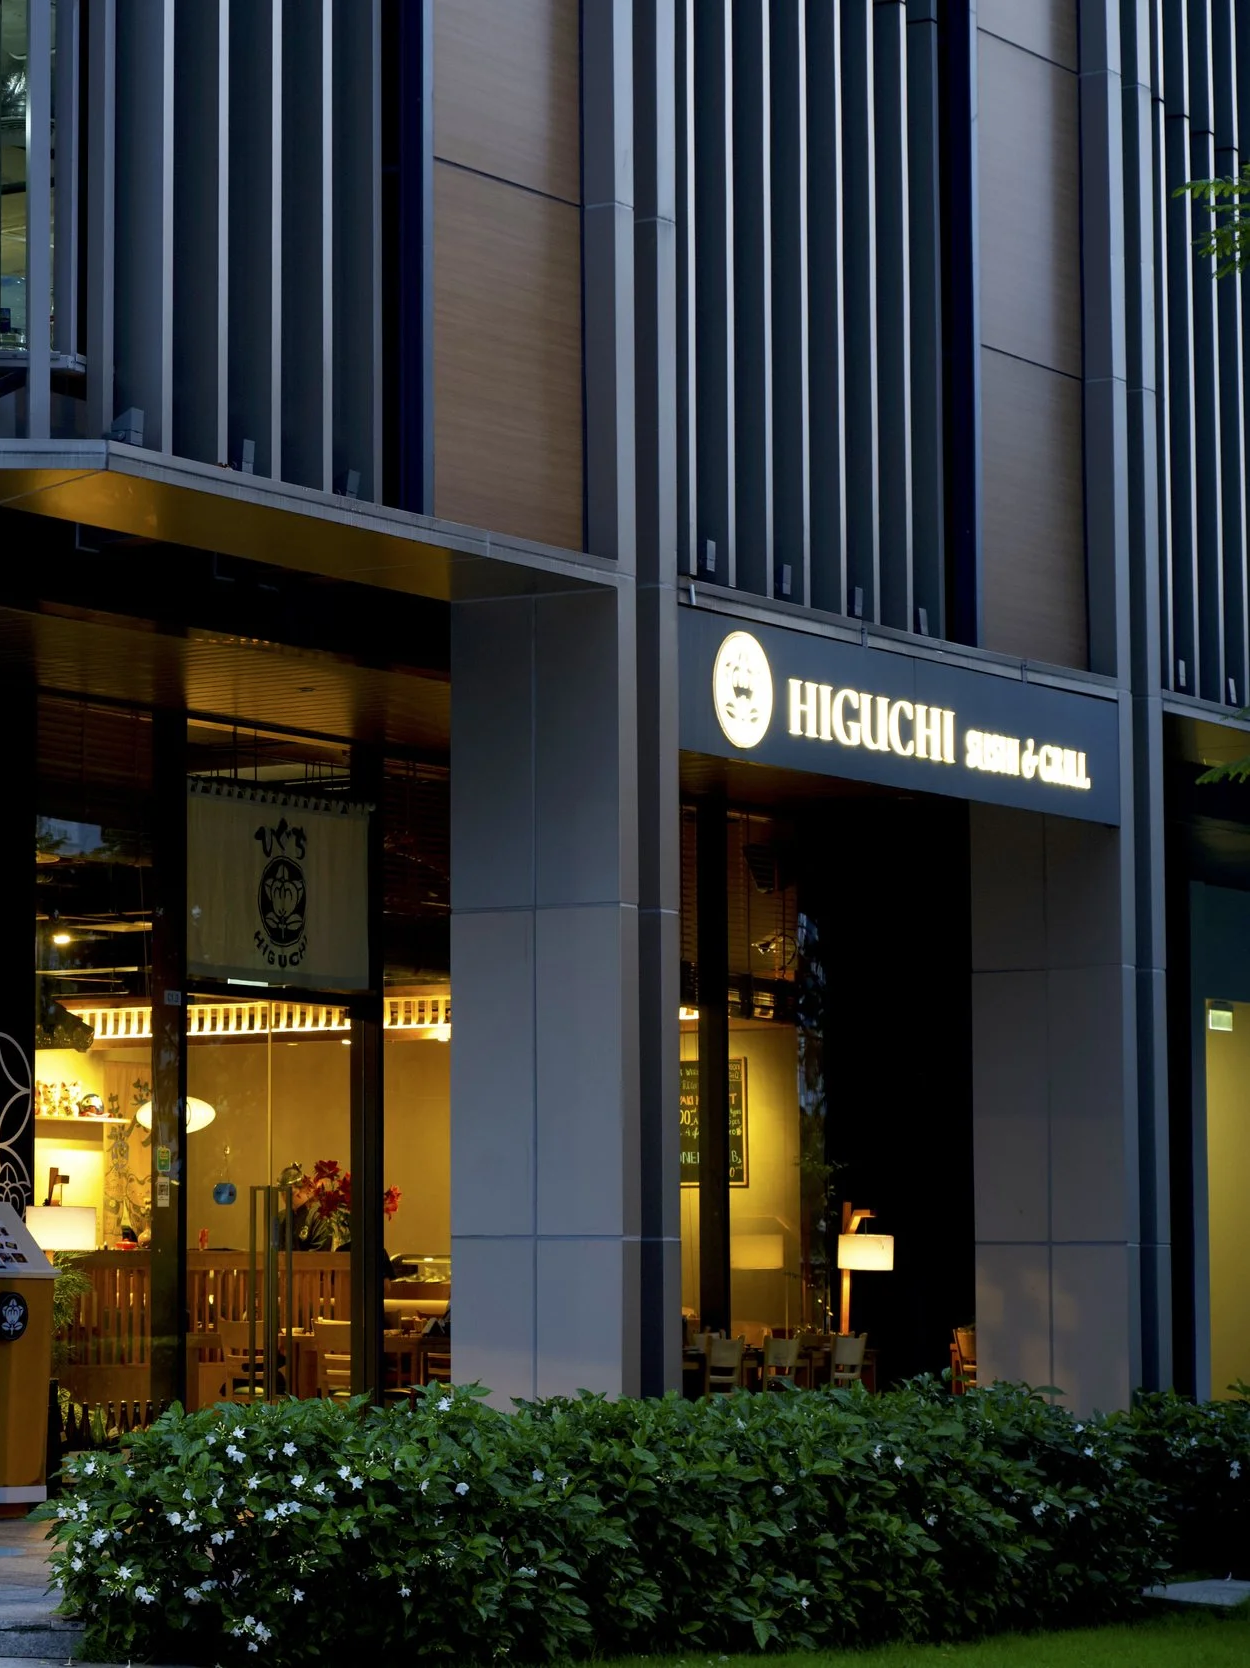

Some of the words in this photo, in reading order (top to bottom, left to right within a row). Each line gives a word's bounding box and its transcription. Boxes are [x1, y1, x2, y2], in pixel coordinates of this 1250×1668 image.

[788, 678, 956, 763] HIGUCHI
[965, 730, 1021, 776] SUSHI
[1021, 738, 1040, 779] &
[1039, 745, 1091, 789] GRILL
[254, 816, 308, 860] ひぐち
[253, 930, 308, 969] HIGUCHI
